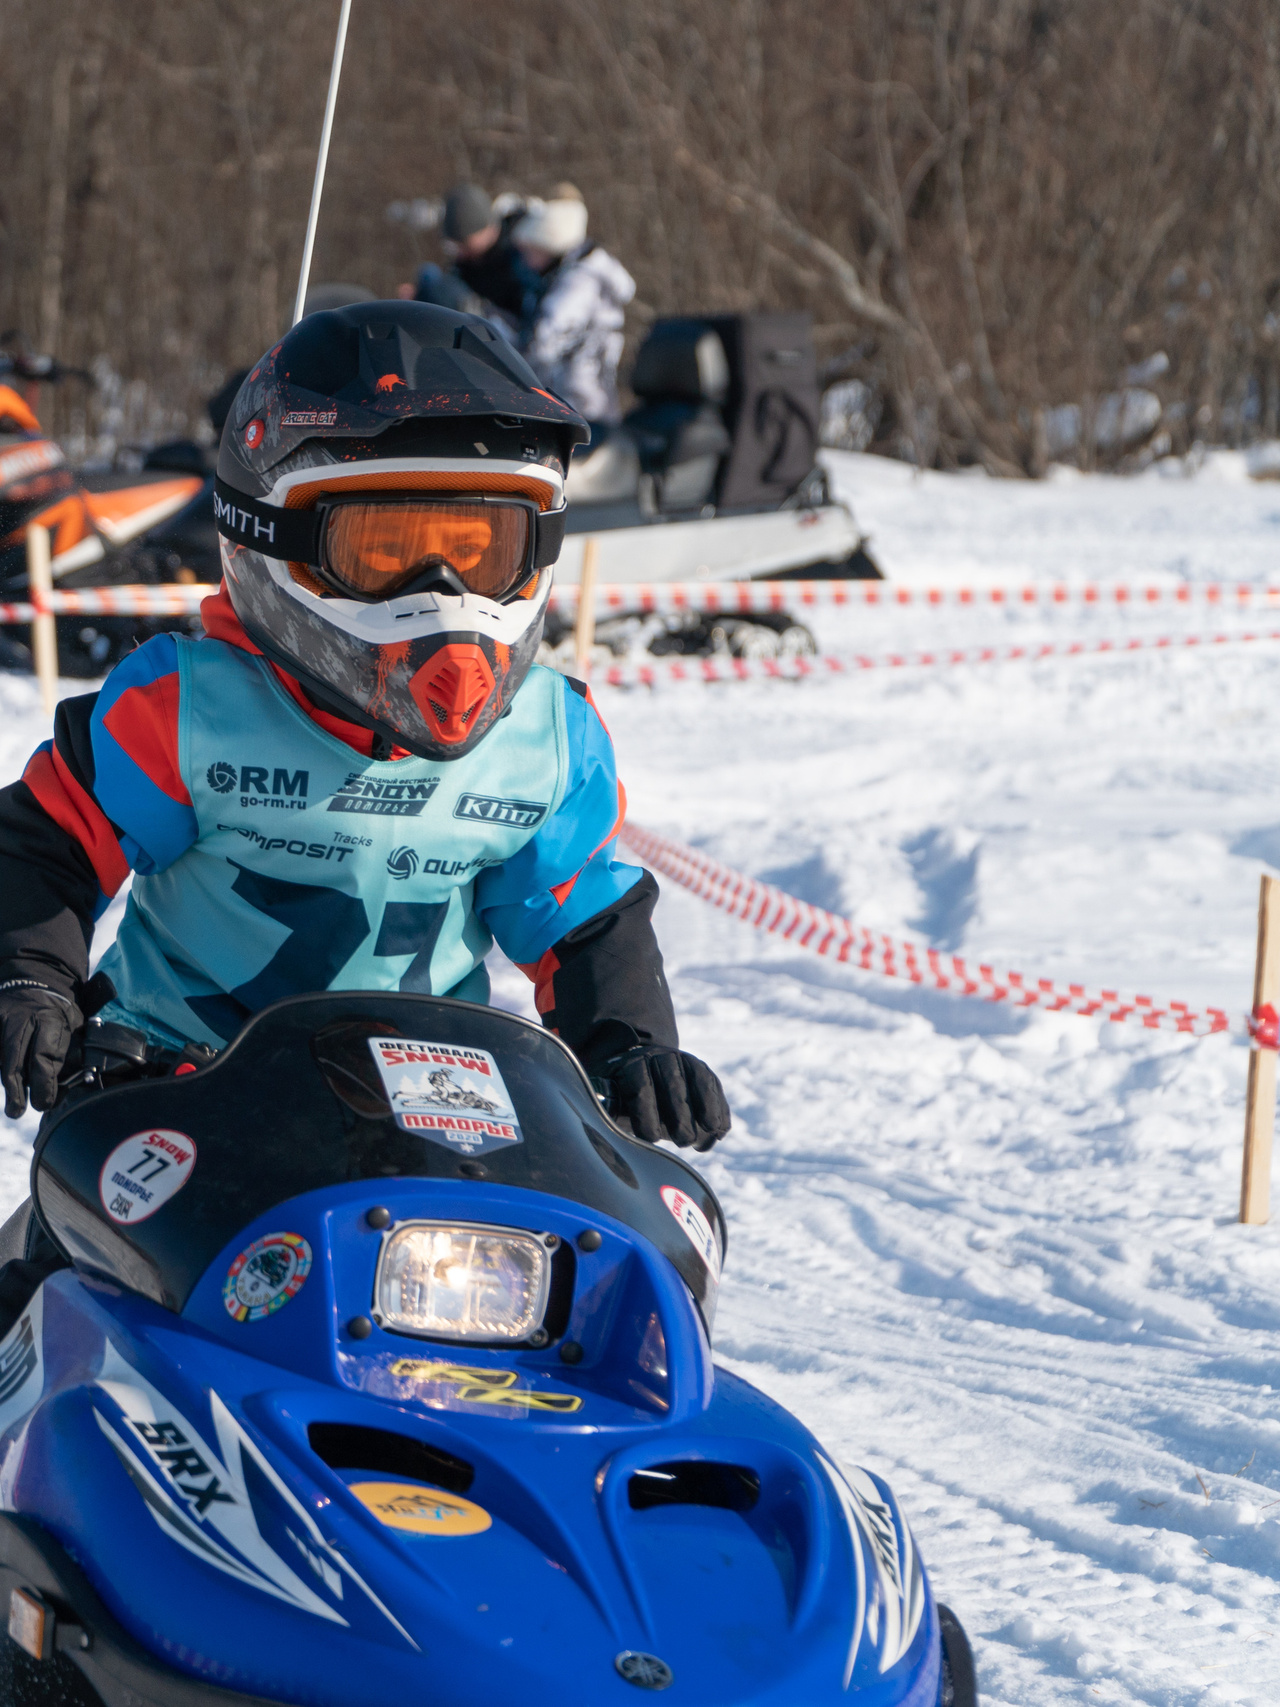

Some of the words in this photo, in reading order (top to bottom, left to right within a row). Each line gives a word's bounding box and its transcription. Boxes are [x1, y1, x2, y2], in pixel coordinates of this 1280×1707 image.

[282, 412, 317, 425] ARCTIC
[317, 412, 337, 425] CAT
[213, 491, 275, 543] SMITH
[240, 766, 309, 797] RM
[337, 778, 439, 799] SNOW
[399, 776, 441, 785] ФЕСТИВАЛЬ
[240, 795, 307, 811] go-rm.ru
[345, 799, 410, 813] ПОМОРЬЕ
[461, 798, 540, 824] Klim
[333, 831, 373, 847] Tracks
[378, 1042, 486, 1061] ФЕСТИВАЛЬ
[382, 1051, 492, 1077] SNOW
[403, 1114, 516, 1139] ПОМОРЬЕ
[448, 1132, 480, 1142] 2020
[142, 1133, 192, 1166] SNOW
[127, 1148, 171, 1183] 77
[111, 1171, 154, 1204] ПОМОРЬЕ
[686, 1209, 706, 1246] 77
[131, 1421, 239, 1517] SRX
